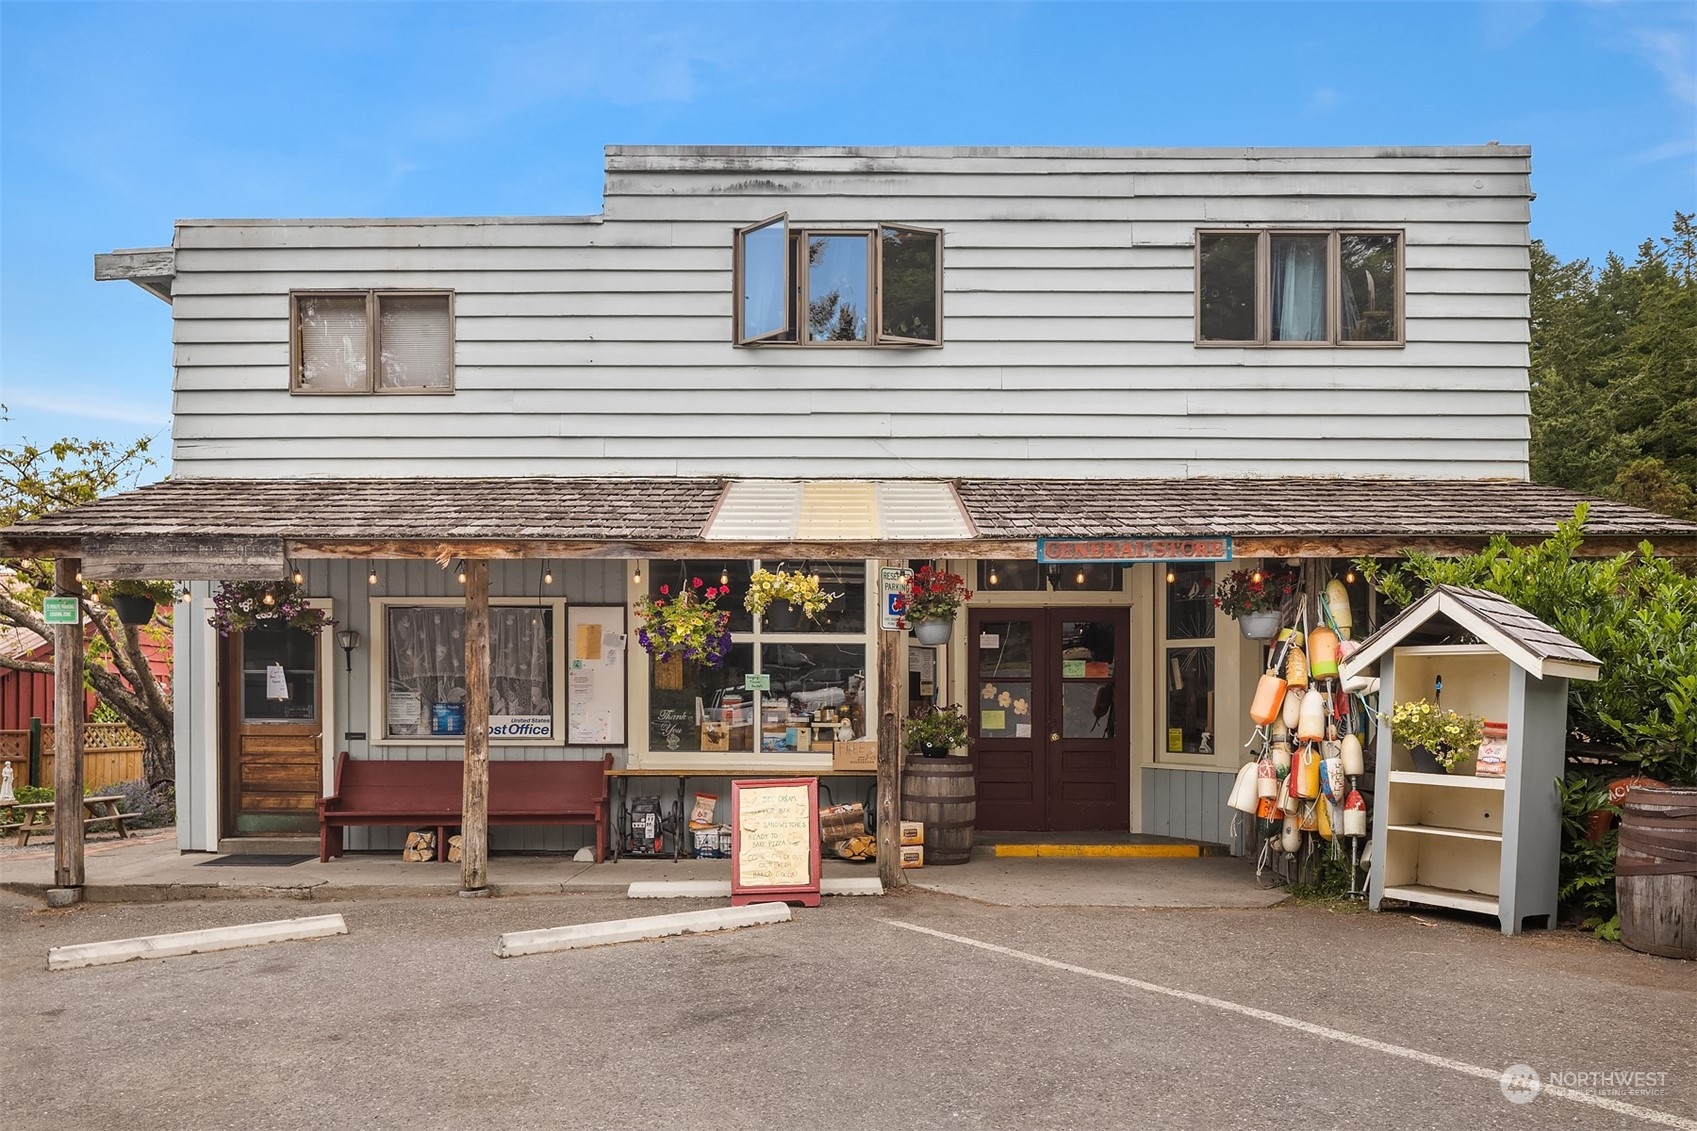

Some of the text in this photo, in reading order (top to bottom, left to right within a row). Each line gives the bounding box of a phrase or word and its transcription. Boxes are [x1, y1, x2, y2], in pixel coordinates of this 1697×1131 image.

[1045, 541, 1223, 559] GENERAL STORE
[657, 709, 687, 721] Thank
[508, 723, 549, 735] Office
[660, 721, 682, 735] You
